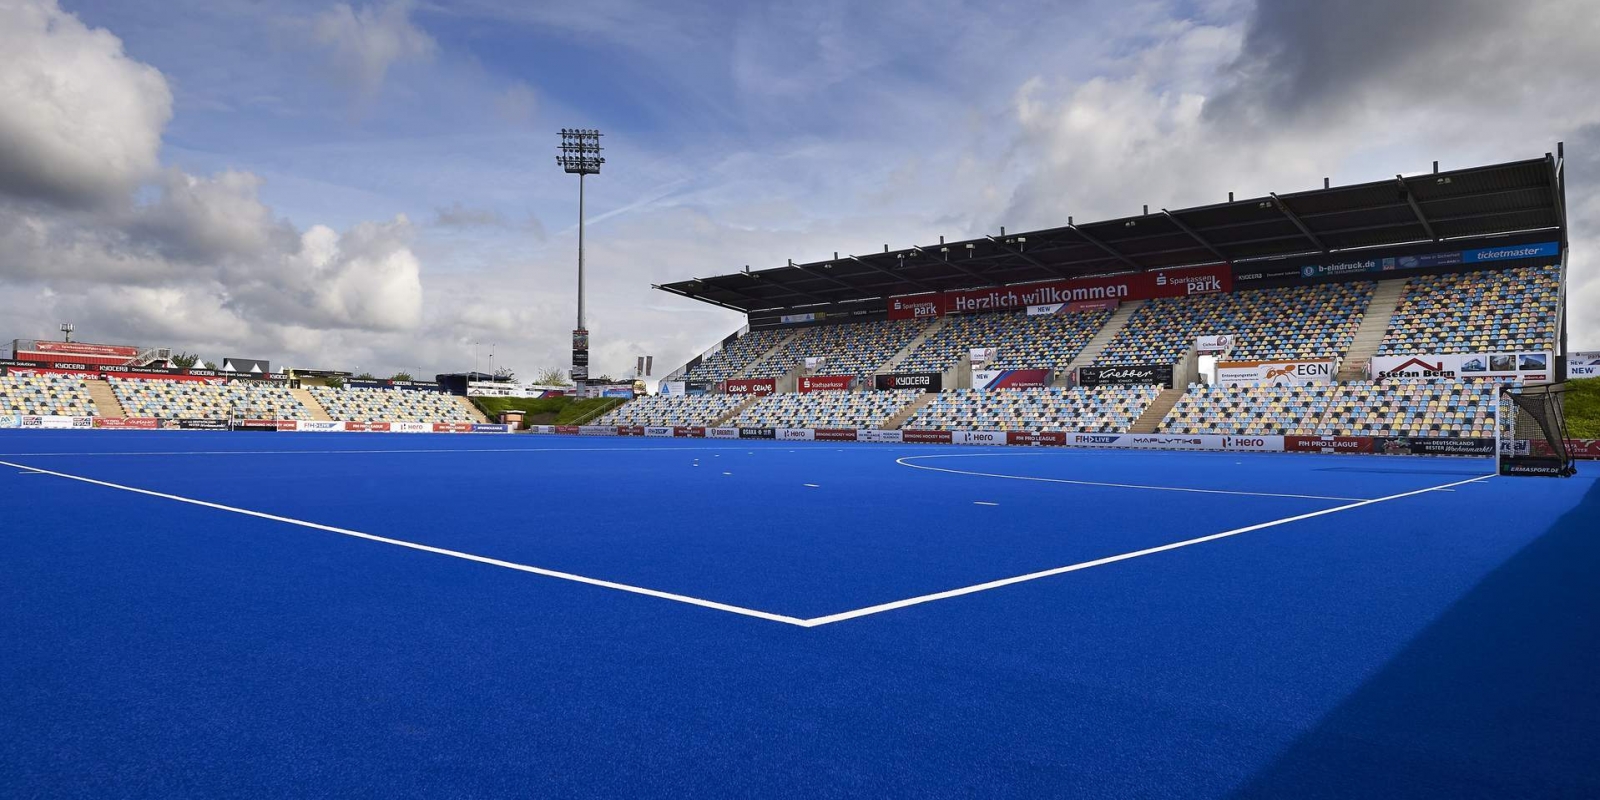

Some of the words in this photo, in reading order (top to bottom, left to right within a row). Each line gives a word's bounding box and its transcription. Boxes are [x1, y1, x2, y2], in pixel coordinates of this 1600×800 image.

[1477, 247, 1540, 259] ticketmaster
[1169, 276, 1211, 286] Sparkassen
[1187, 275, 1220, 294] park
[956, 290, 1018, 310] Herzlich
[1022, 282, 1128, 304] willkommen
[914, 302, 936, 317] park
[1297, 364, 1328, 376] EGN
[896, 376, 930, 386] KYOCERA
[1236, 438, 1264, 446] Hero
